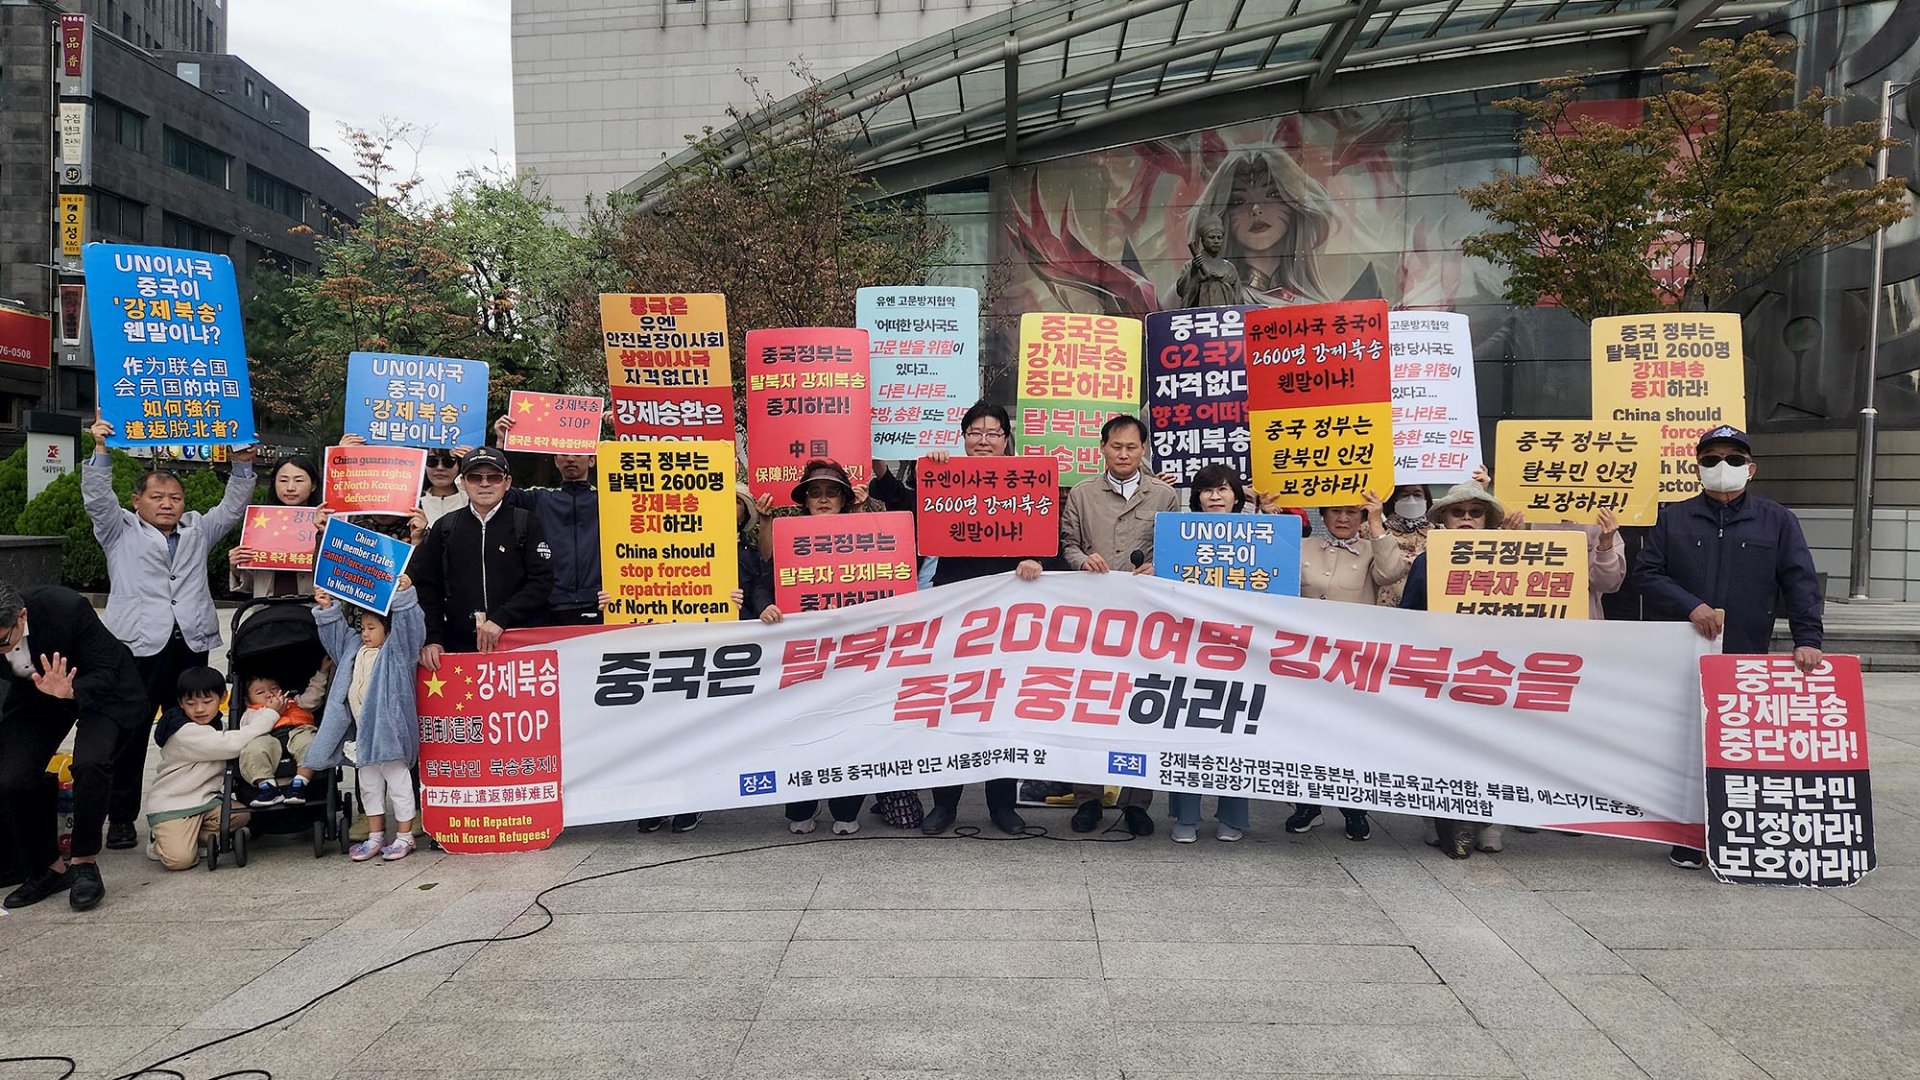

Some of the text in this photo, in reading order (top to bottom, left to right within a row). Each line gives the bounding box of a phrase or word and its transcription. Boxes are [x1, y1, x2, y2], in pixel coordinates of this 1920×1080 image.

[67, 170, 78, 179] 3F
[65, 213, 79, 239] 오성
[114, 253, 213, 280] UN이사국
[136, 276, 200, 300] 중국이
[629, 296, 688, 316] 중국은
[876, 295, 956, 307] 유엔 고문방지협약
[123, 320, 222, 345] 웬말이냐?
[640, 316, 677, 331] 유엔
[913, 319, 959, 333] 당사국도
[1041, 315, 1119, 344] 중국은
[1170, 311, 1244, 341] 중국은
[1249, 313, 1382, 342] 유엔이사국 중국이
[1621, 322, 1715, 342] 중국 정부는
[605, 331, 725, 349] 안전보장이사회
[870, 340, 965, 355] 고문 위험이
[1407, 342, 1455, 356] 당사국도
[67, 353, 76, 361] B1
[619, 349, 711, 368] 상임이사국
[762, 345, 852, 364] 중국정부는
[1026, 343, 1128, 372] 강제북송
[1160, 343, 1200, 369] G2
[1252, 343, 1306, 366] 2600명
[1311, 339, 1384, 364] 강제북송
[1606, 341, 1730, 362] 탈북민 2600명
[123, 356, 228, 378] 作为联合国
[372, 358, 465, 383] UN이사국
[623, 368, 709, 386] 자격없다!
[1393, 363, 1461, 379] 받을 위험이
[1633, 361, 1705, 379] 강제북송
[113, 377, 240, 398] 会员国的中国
[387, 380, 446, 402] 중국이
[751, 372, 866, 392] 탈북자 강제북송
[878, 384, 905, 399] 다른
[1025, 370, 1134, 400] 중단하라!
[1155, 371, 1203, 400] 자격
[1277, 369, 1355, 393] 웬말이냐!
[1630, 379, 1709, 399] 중지하라!
[554, 398, 599, 413] 강제북송
[615, 399, 724, 426] 강제송환은
[767, 396, 851, 416] 중지하라!
[894, 407, 945, 422] 송환 또는
[1151, 402, 1192, 428] 향후
[1612, 407, 1722, 422] China should
[559, 416, 590, 428] STOP
[1264, 416, 1373, 441] 중국 정부는
[369, 421, 462, 445] 웬말이냐?
[873, 430, 933, 445] 하여서는 안
[1153, 427, 1250, 457] 강제북송
[1423, 429, 1475, 445] 또는 인도
[1516, 430, 1564, 453] 중국
[1570, 430, 1638, 452] 정부는
[332, 455, 415, 467] China guarantees
[620, 452, 709, 471] 중국 정부는
[1272, 443, 1375, 469] 탈북민 인권
[1421, 453, 1436, 468] 안
[381, 469, 412, 480] rights
[608, 472, 724, 492] 탈북민 2600명
[921, 469, 1051, 488] 유엔이사국 중국이
[1522, 462, 1588, 484] 탈북민
[1596, 460, 1638, 484] 인권
[343, 481, 408, 492] North Korean
[1280, 473, 1368, 496] 보장하라!
[344, 493, 391, 503] defectors!
[631, 493, 699, 513] 강제북송
[924, 494, 1053, 515] 2600명 강제북송
[1528, 492, 1628, 513] 보장하라!
[630, 514, 703, 534] 중지하라!
[949, 521, 1023, 542] 웬말이냐!
[1181, 521, 1274, 544] UN이사국
[355, 532, 378, 547] China!
[792, 533, 896, 556] 중국정부는
[331, 537, 395, 568] UN member states
[616, 543, 715, 559] China should
[1196, 544, 1256, 566] 중국이
[1450, 540, 1568, 566] 중국정부는
[342, 569, 376, 590] repatriate
[620, 562, 711, 581] stop forced
[779, 561, 912, 586] 탈북자 강제북송
[335, 578, 378, 604] North Korea!
[620, 581, 712, 600] repatriation
[1445, 570, 1574, 598] 탈북자 인권
[608, 600, 729, 614] of North Korean
[594, 602, 1584, 713] 중국은 탈북민 2600여명 강제북송을
[477, 658, 558, 700] 강제북송
[1735, 659, 1836, 693] 중국은
[893, 665, 1267, 735] 즉각 중단하라!
[1717, 694, 1848, 728] 강제북송
[488, 709, 549, 745] STOP
[1718, 728, 1858, 763] 중단하라!
[426, 756, 557, 777] 탈북난민 북송중지!
[742, 747, 1047, 794] 장소 서울 명동 중국대사관 인근 서울중앙우체국 앞
[1111, 751, 1534, 803] 주최 강제북송진상규명국민운동본부, 바른교육교수연합, 북클럽,
[428, 785, 556, 804] 中方停止遣返朝鲜难民
[1159, 770, 1495, 817] 전국통일광장기도연합, 탈북민강제북송반대세계연합
[1724, 774, 1857, 810] 탈북난민
[449, 815, 533, 829] Do Not Repatrate
[1721, 811, 1863, 846] 인정하라!
[435, 828, 550, 844] North Korean Refugees!
[1718, 846, 1869, 882] 보호하라!!
